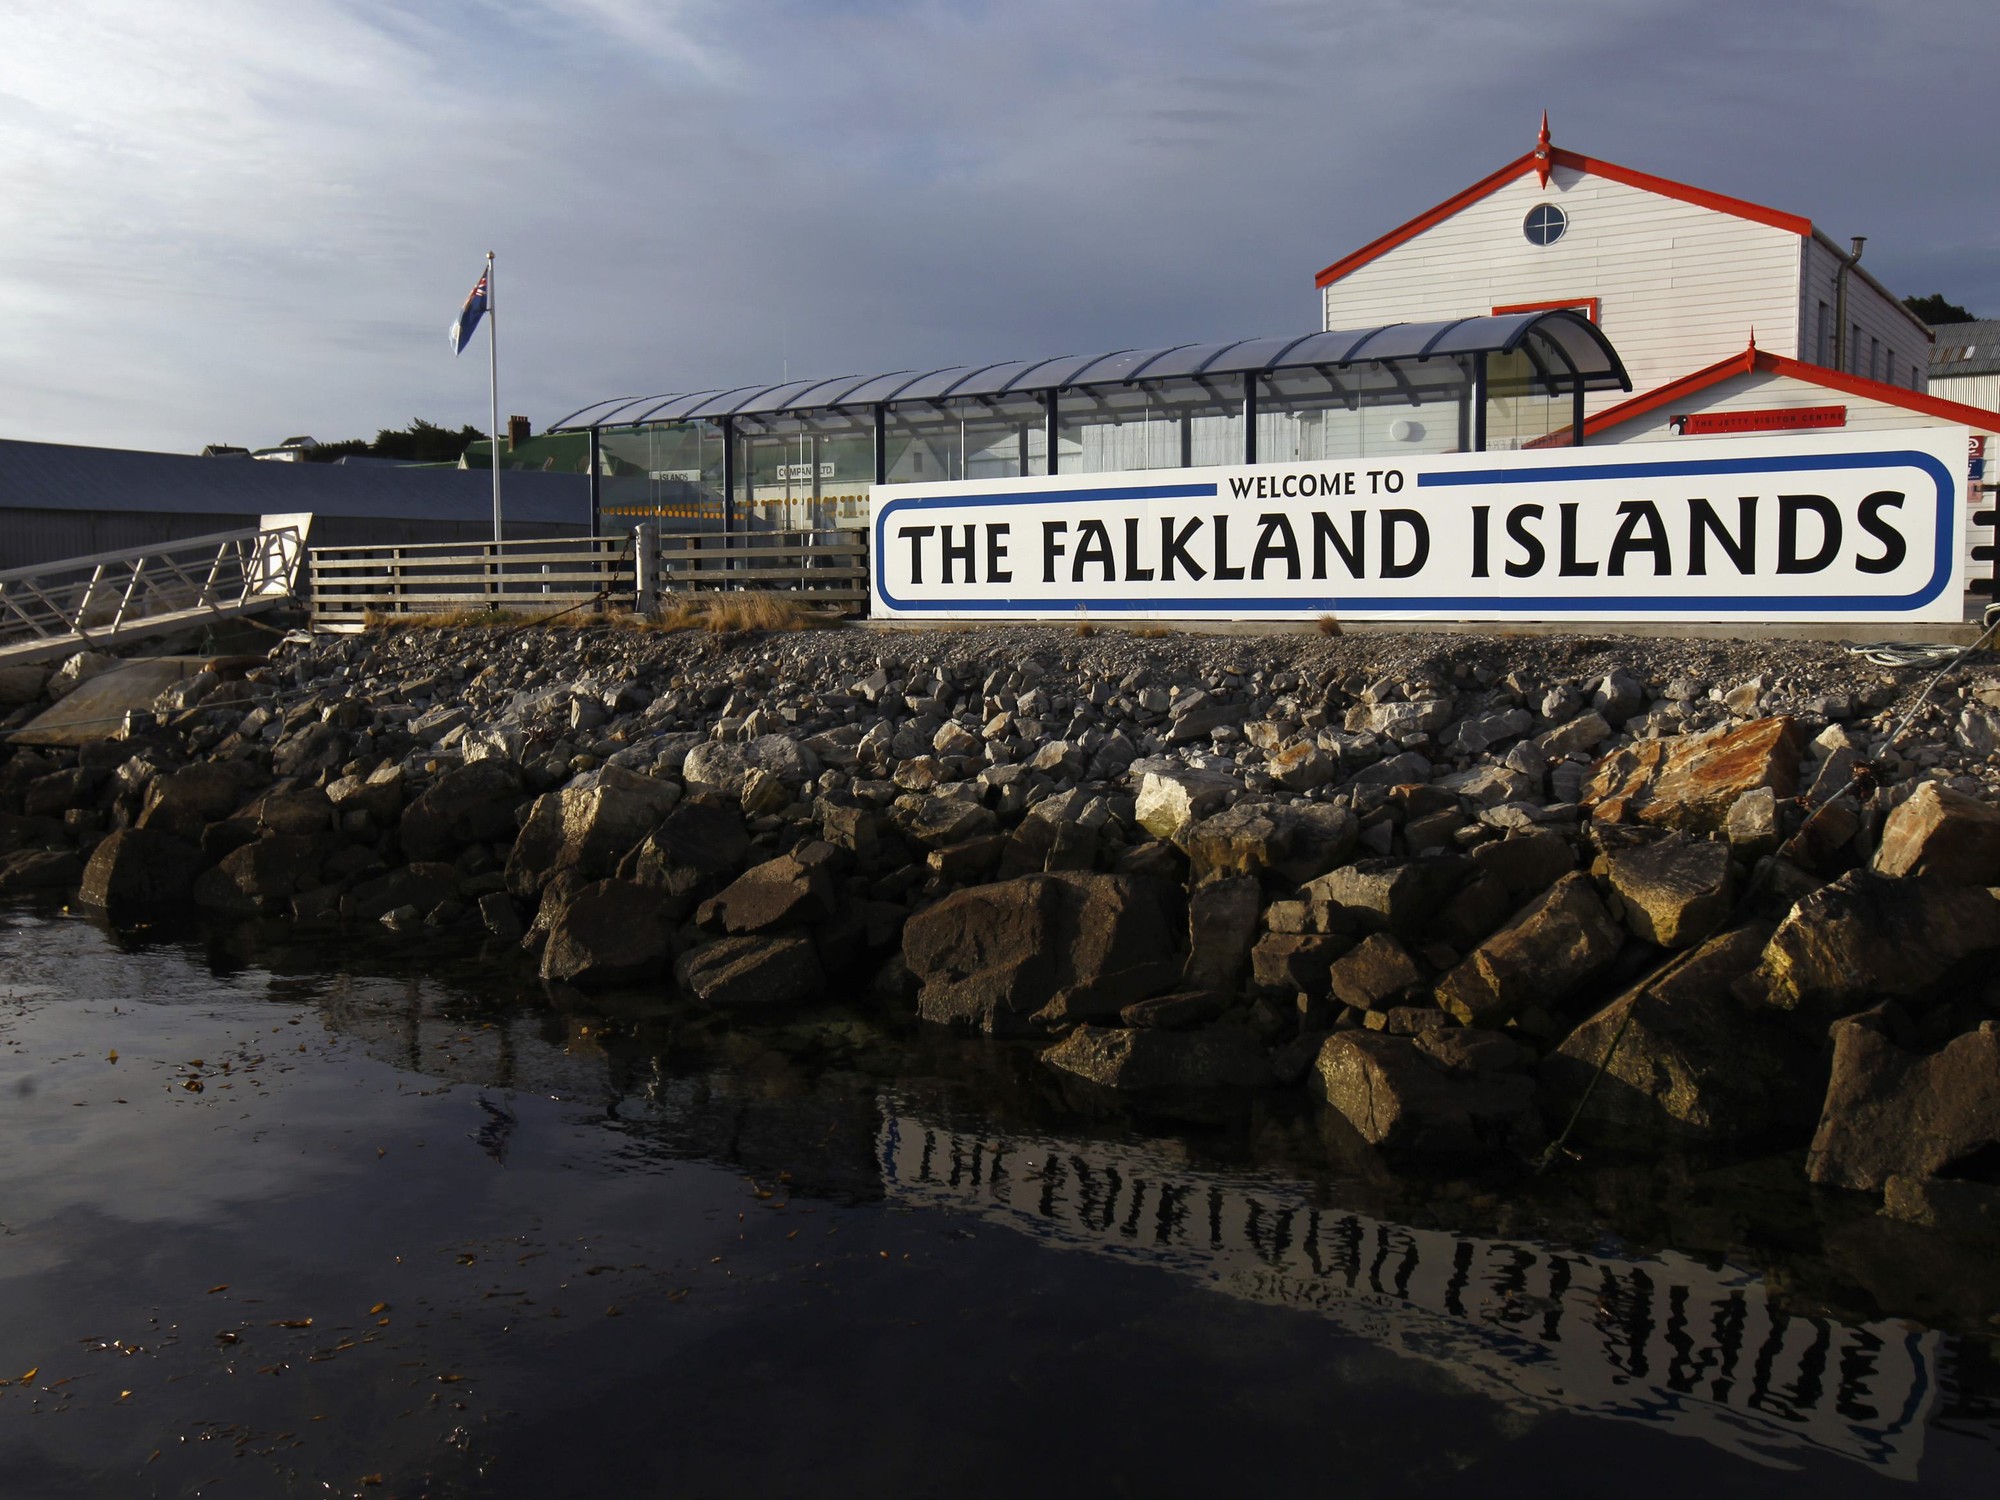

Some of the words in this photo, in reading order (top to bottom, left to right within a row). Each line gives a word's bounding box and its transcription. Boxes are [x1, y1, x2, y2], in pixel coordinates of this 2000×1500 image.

[1695, 420, 1713, 428] THE
[1718, 418, 1749, 427] JETTY
[1754, 415, 1797, 425] VISITOR
[1802, 412, 1843, 422] CENTRE
[779, 466, 814, 477] CMPAN
[1229, 472, 1356, 500] WELCOME
[1366, 470, 1404, 494] TO
[897, 522, 1013, 585] THE
[1041, 508, 1430, 583] FALKLAND
[1471, 490, 1907, 578] ISLANDS
